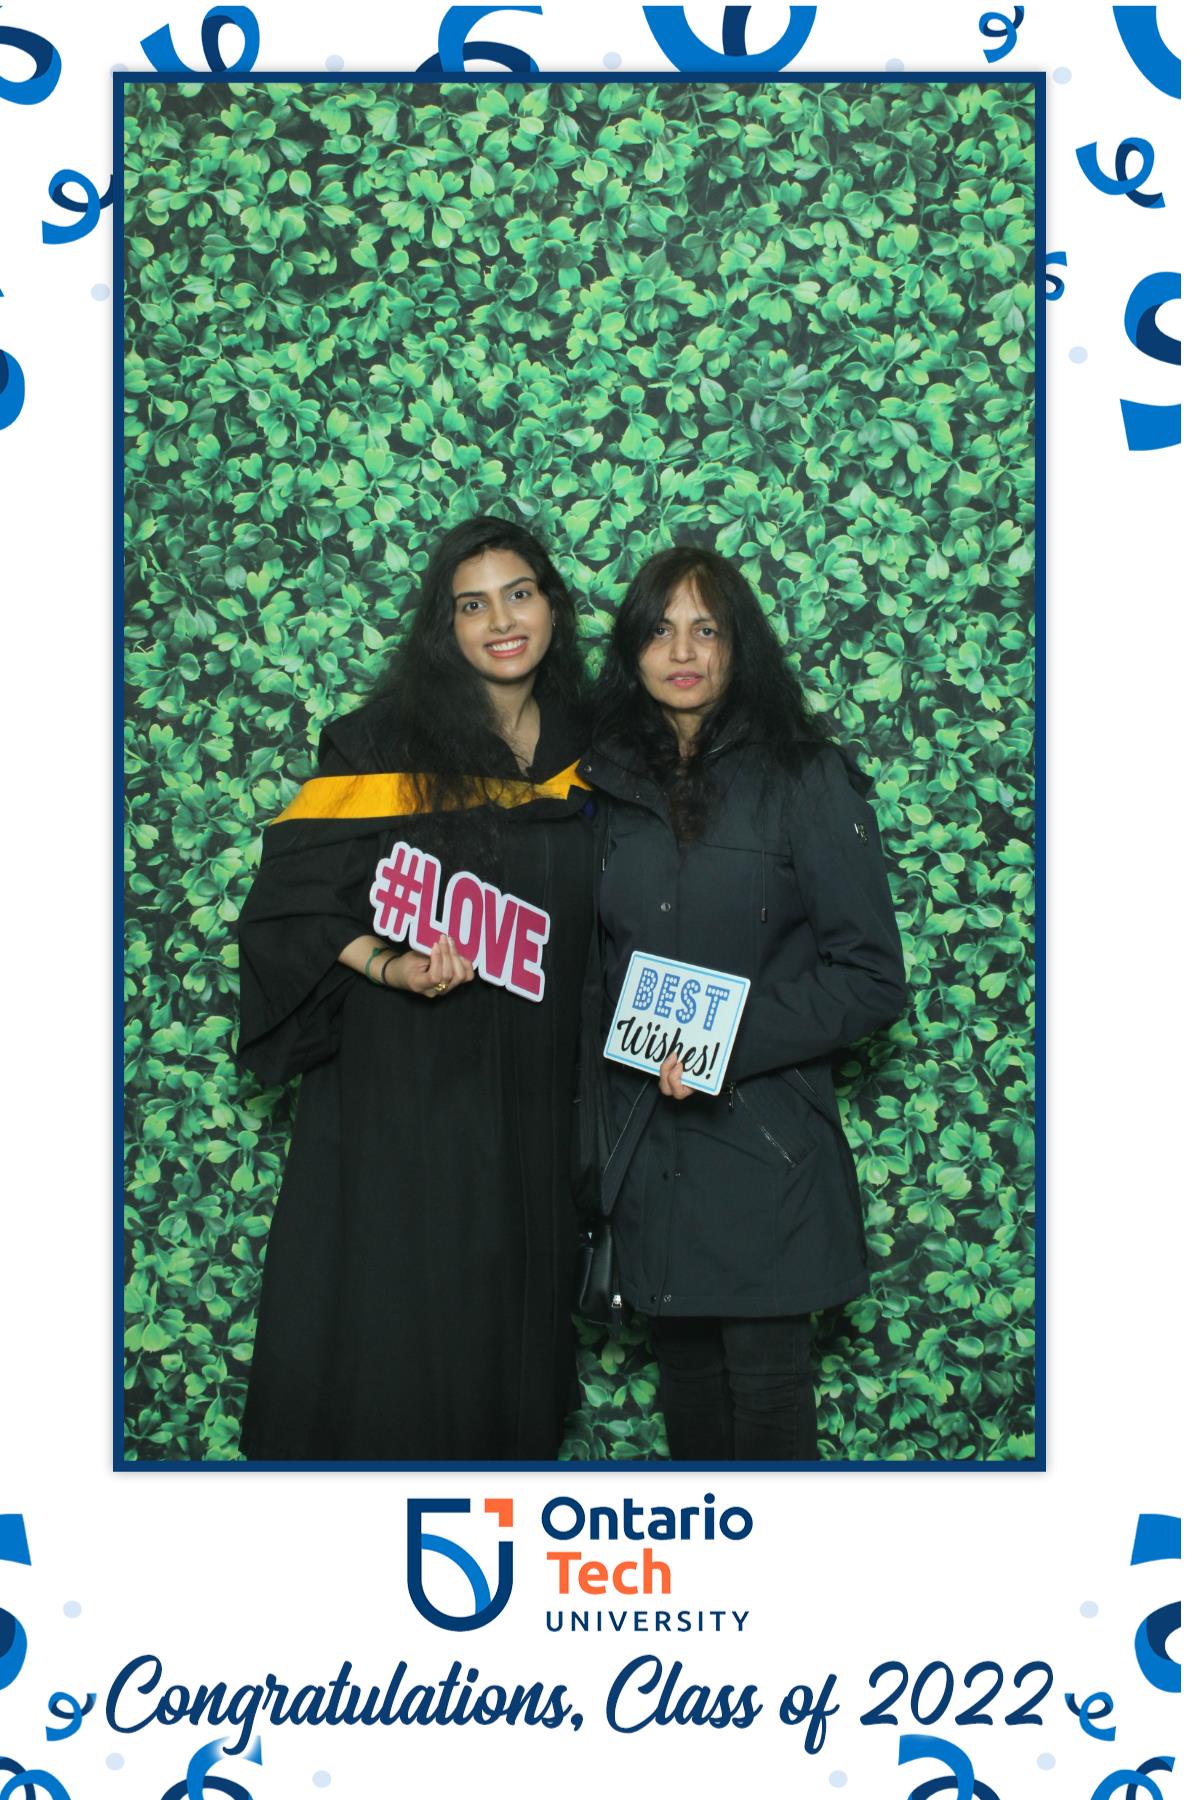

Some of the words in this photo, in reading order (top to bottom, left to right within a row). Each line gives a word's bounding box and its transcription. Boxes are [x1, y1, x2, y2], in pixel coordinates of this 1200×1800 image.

[375, 847, 547, 996] #LOVE
[632, 966, 731, 1032] BEST
[616, 1016, 721, 1080] Wishes!
